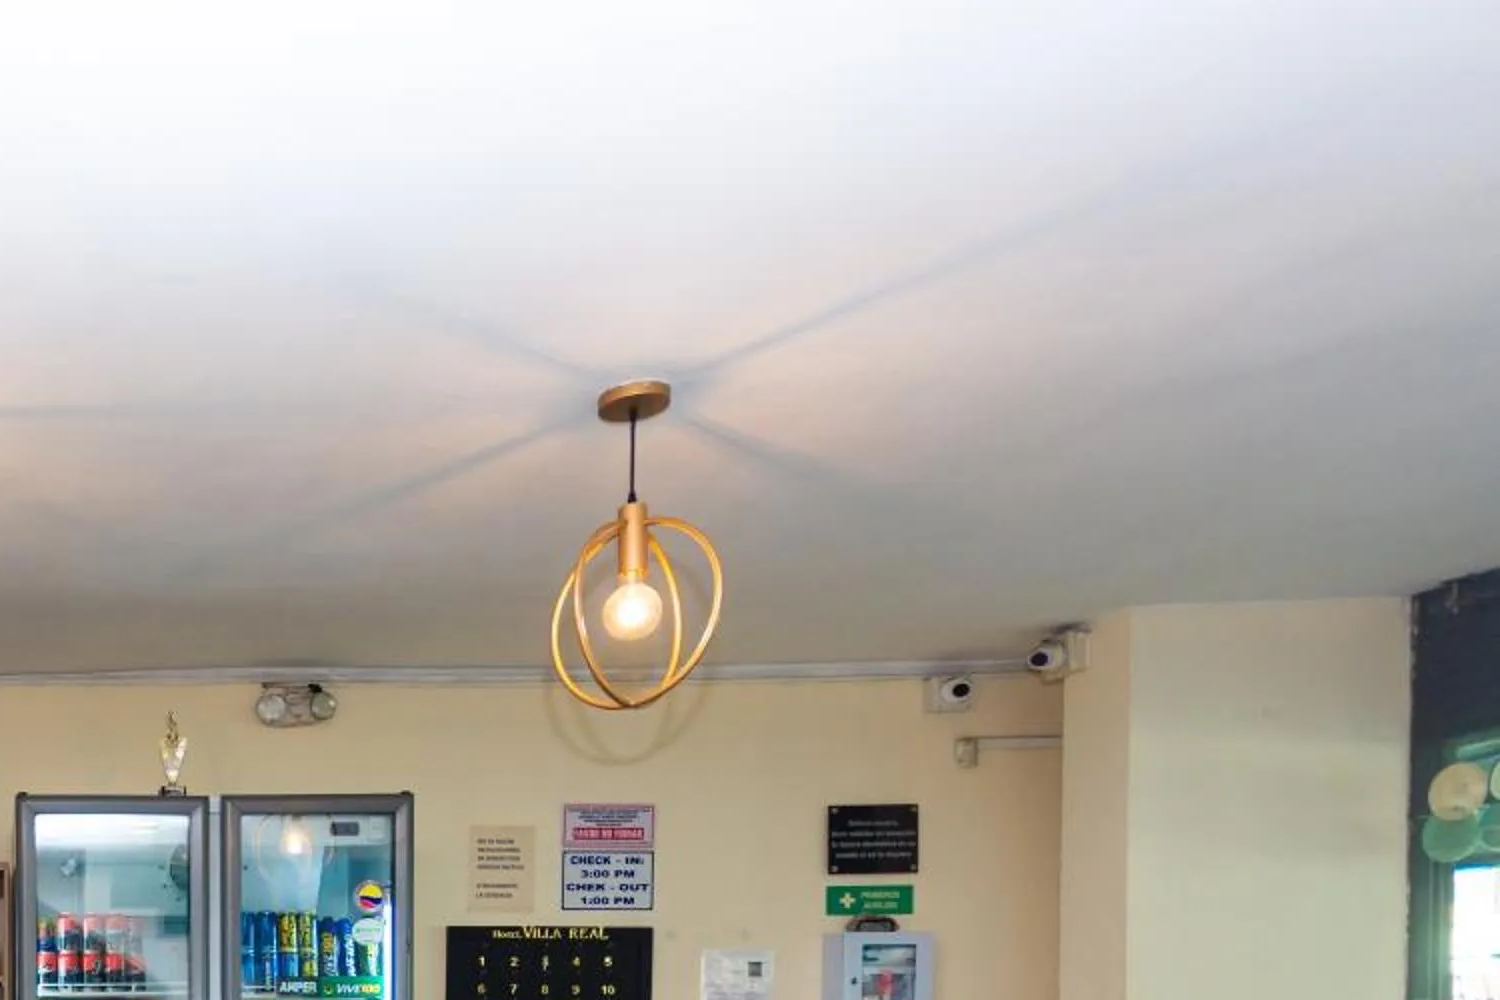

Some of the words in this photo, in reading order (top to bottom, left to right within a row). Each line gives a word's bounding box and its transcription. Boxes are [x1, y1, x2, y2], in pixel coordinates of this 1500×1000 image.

[570, 855, 611, 865] CHECK
[581, 869, 610, 879] 3:00
[614, 869, 635, 878] PM
[619, 883, 650, 892] OUT
[581, 896, 610, 905] 1:00
[614, 896, 635, 905] PM
[522, 926, 562, 939] VILLA
[569, 927, 609, 940] REAL
[478, 955, 486, 967] 1
[509, 956, 519, 967] 2
[572, 956, 581, 967] 4
[603, 955, 613, 967] 5
[279, 981, 317, 993] AMPER
[510, 983, 518, 995] 7
[601, 984, 616, 995] 10
